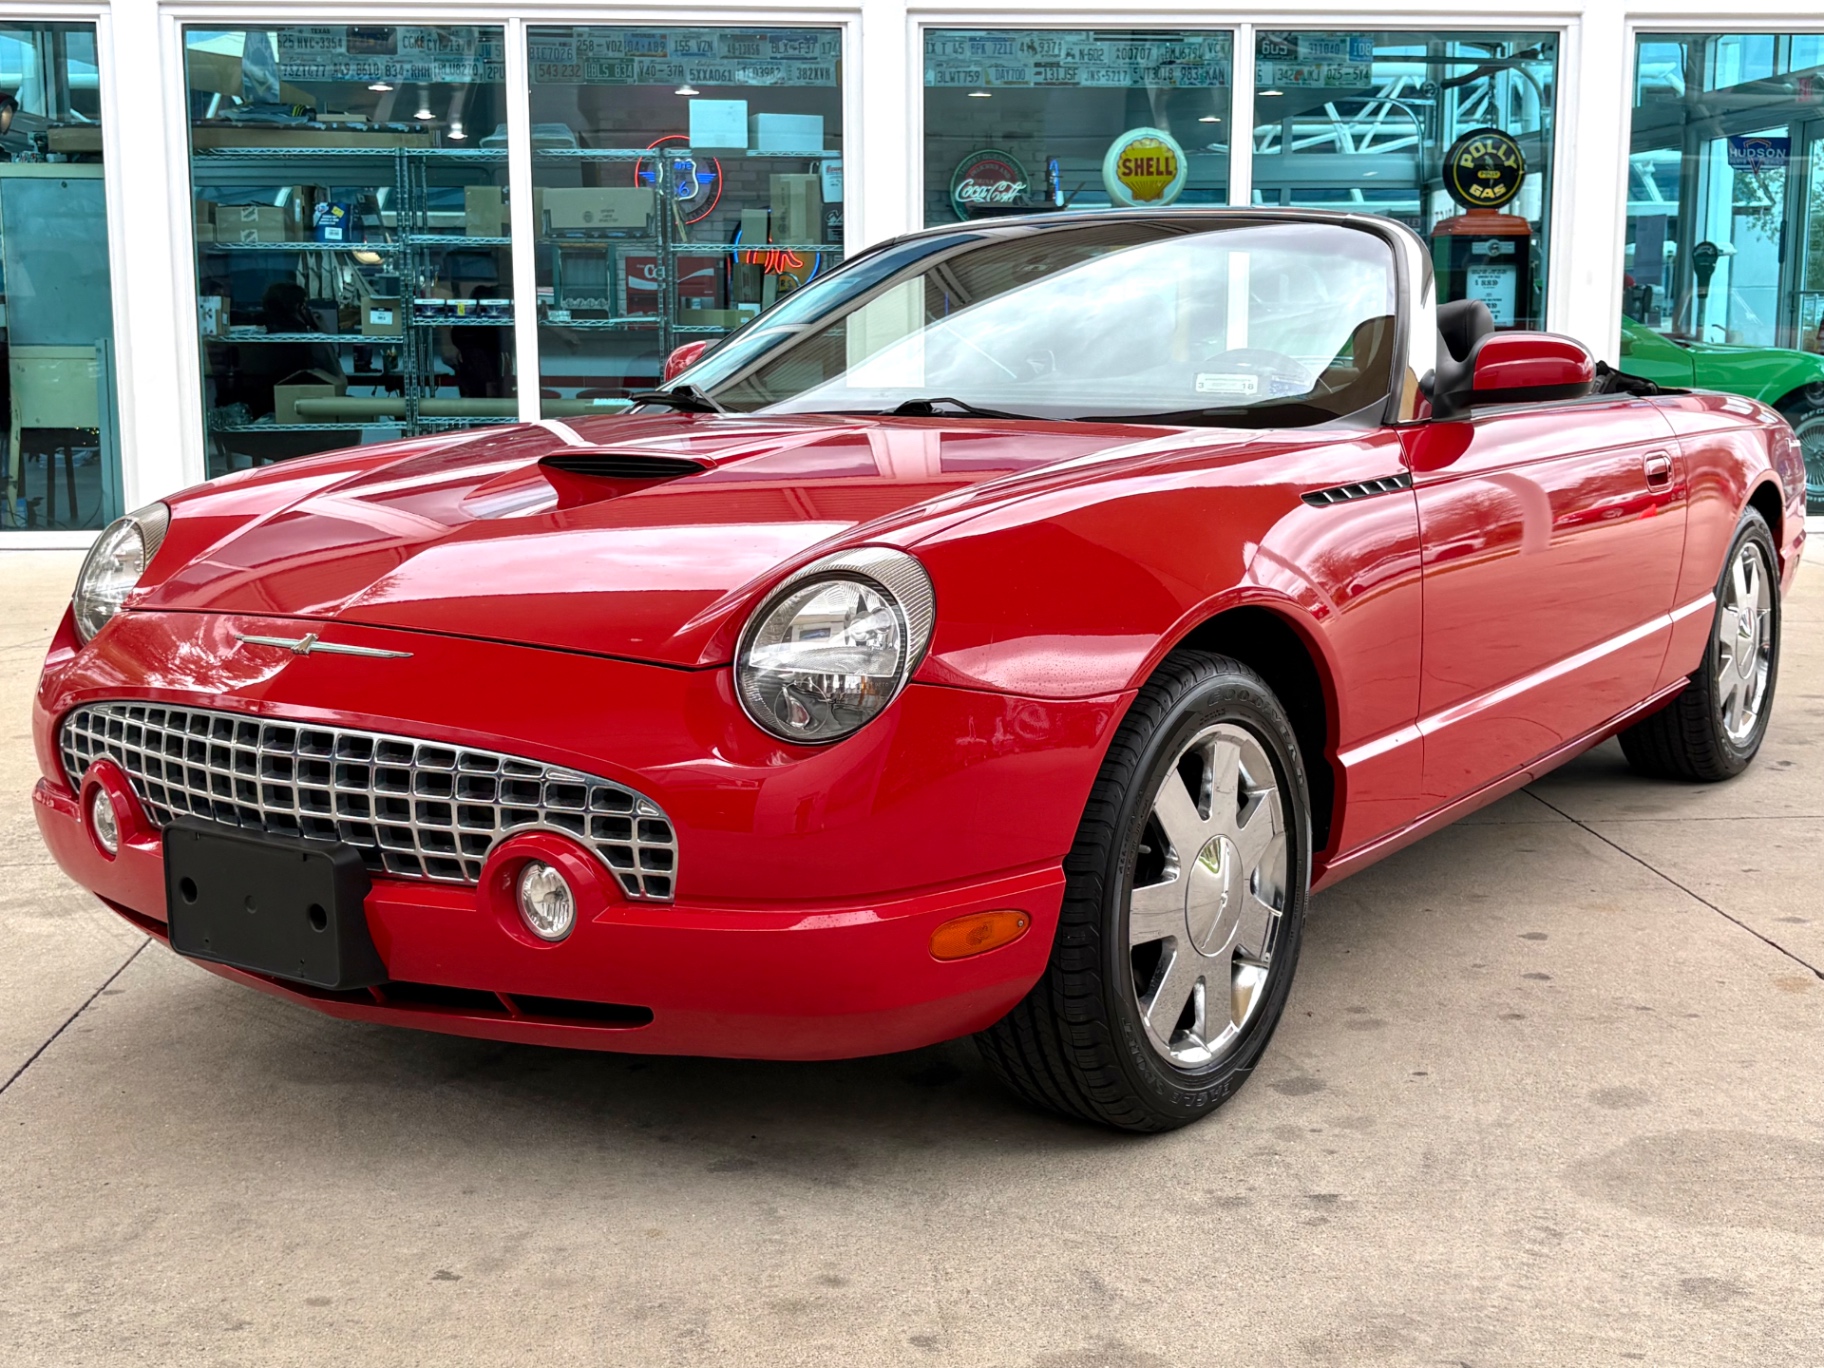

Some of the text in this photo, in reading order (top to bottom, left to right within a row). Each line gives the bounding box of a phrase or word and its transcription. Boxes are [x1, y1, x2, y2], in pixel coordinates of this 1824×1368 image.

[1460, 139, 1517, 169] POLLY
[1729, 148, 1786, 158] HUDSON
[1122, 156, 1173, 177] SHELL
[1469, 183, 1507, 198] GAS
